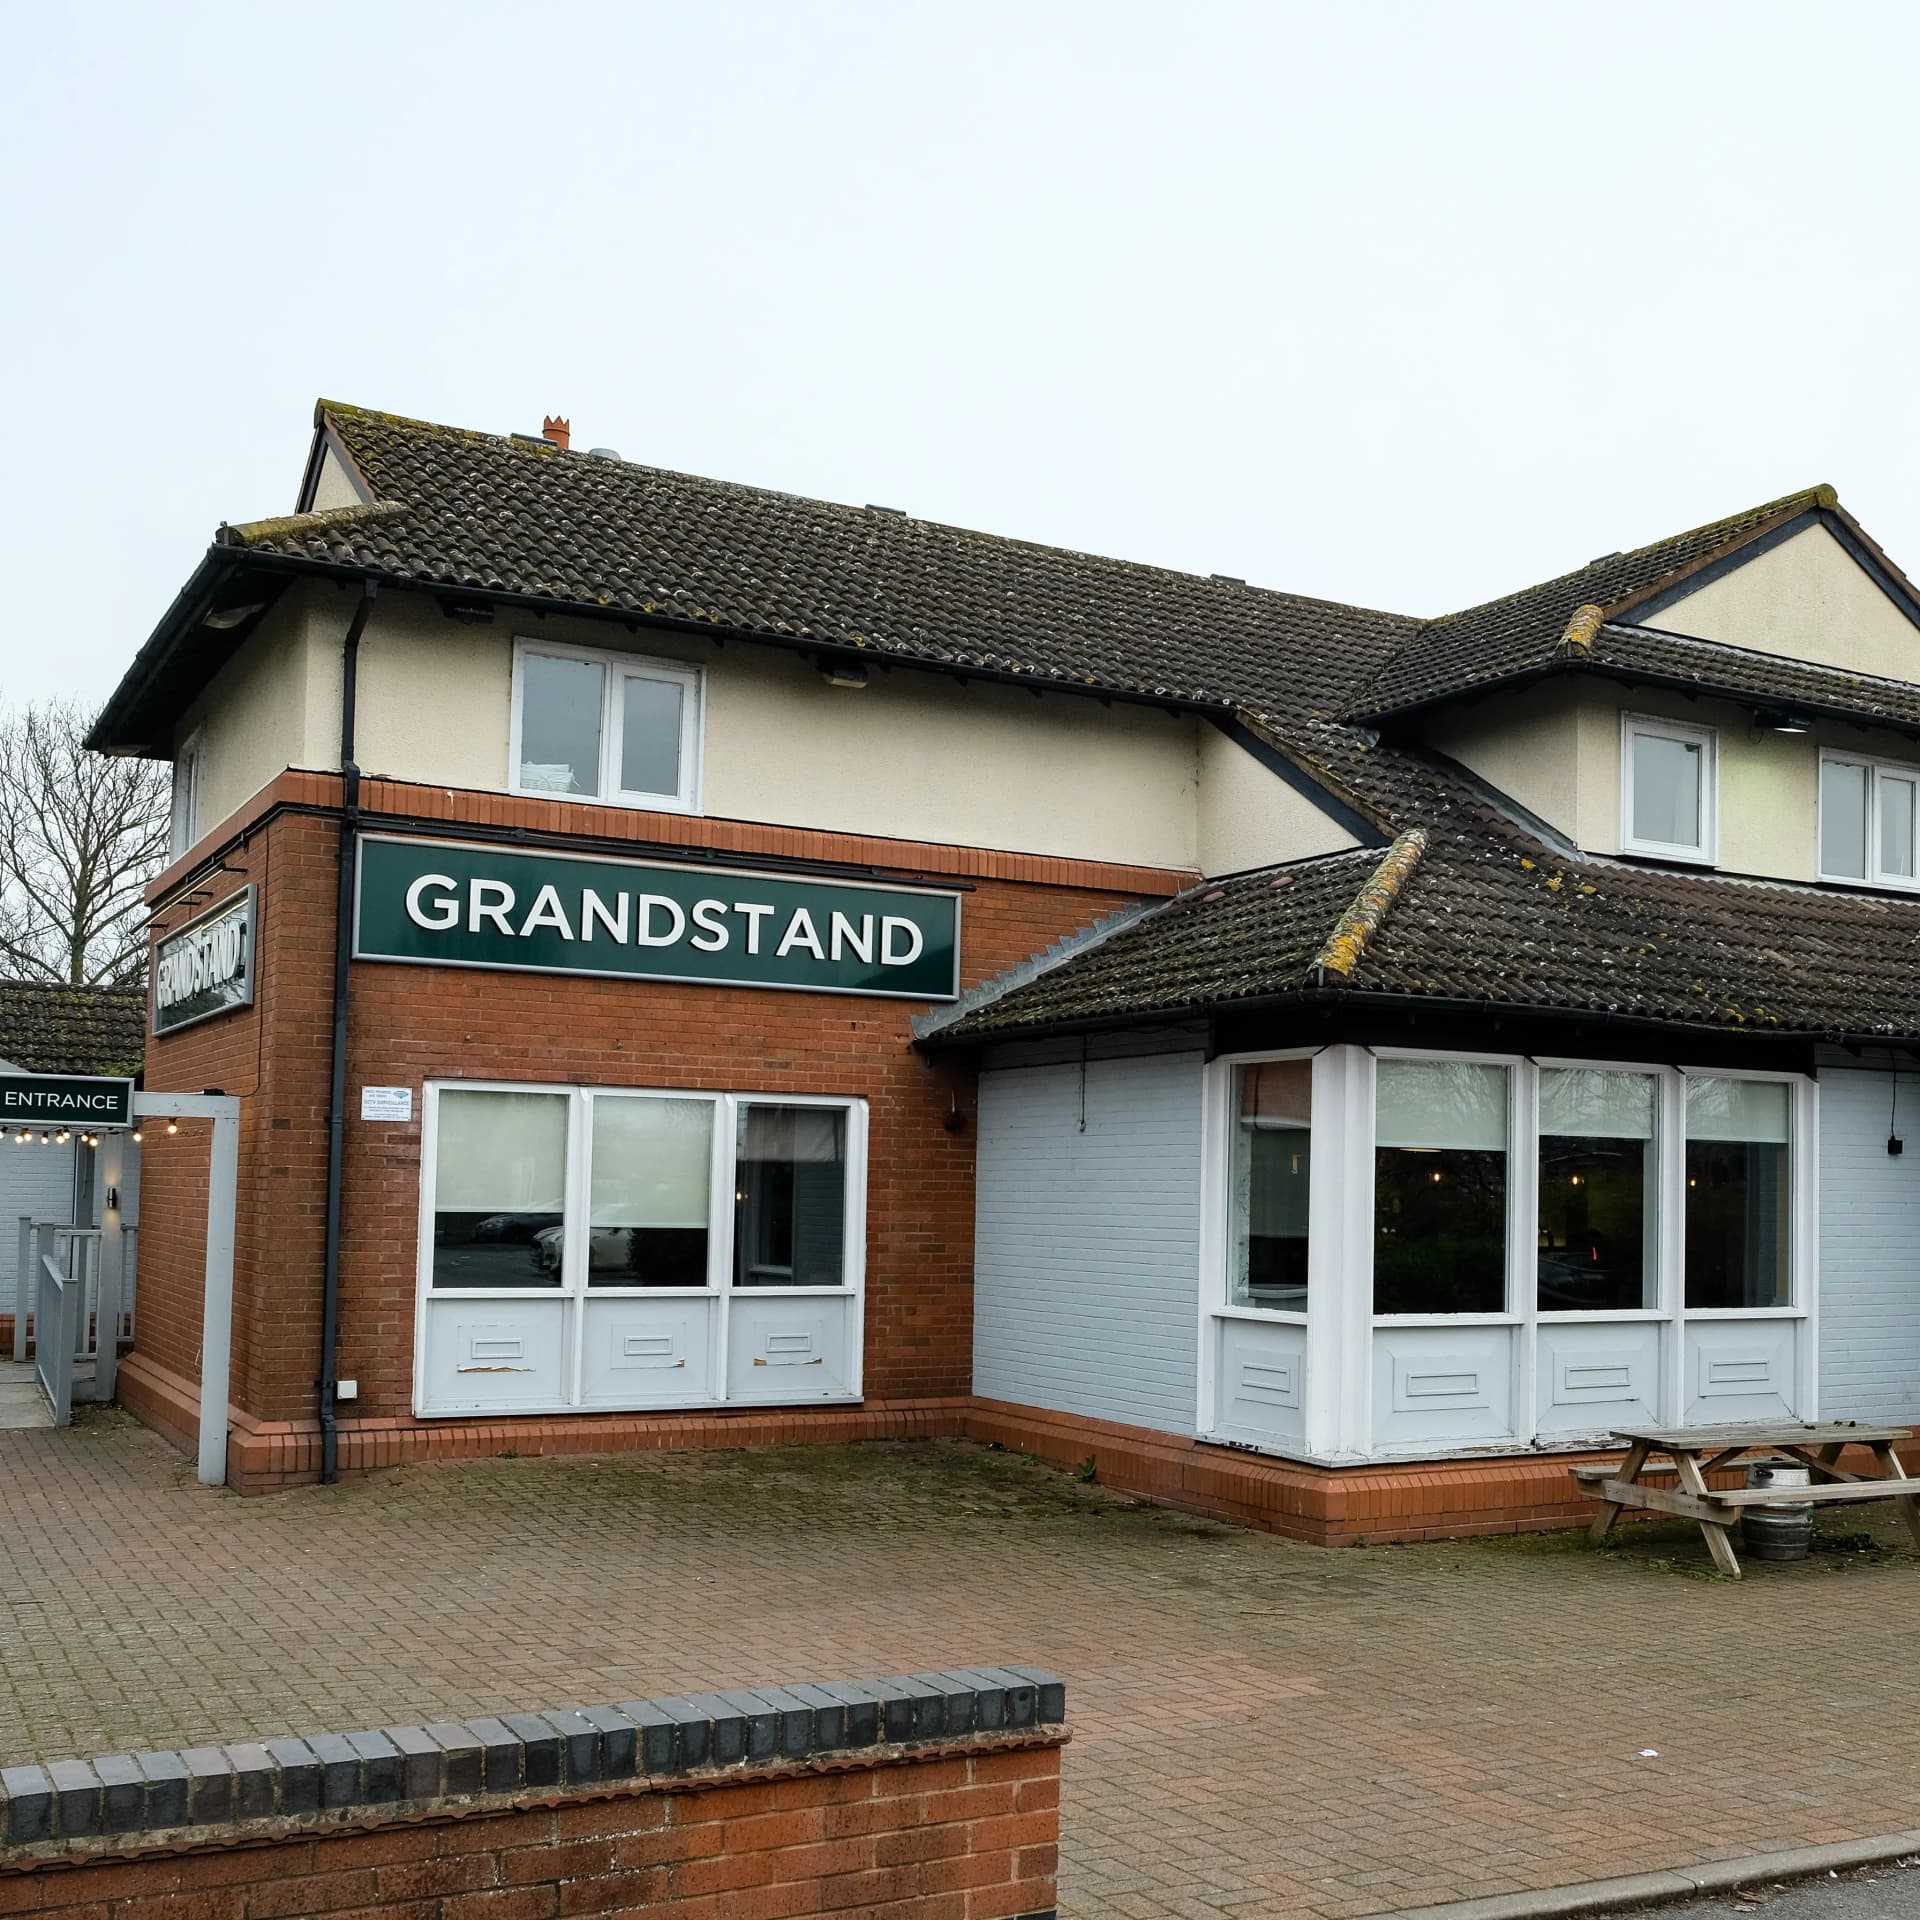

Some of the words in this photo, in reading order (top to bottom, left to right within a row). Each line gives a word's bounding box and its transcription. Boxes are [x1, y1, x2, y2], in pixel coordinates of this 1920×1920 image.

[157, 919, 240, 1010] GRANDSTAND
[406, 874, 924, 966] GRANDSTAND
[5, 1091, 119, 1110] ENTRANCE
